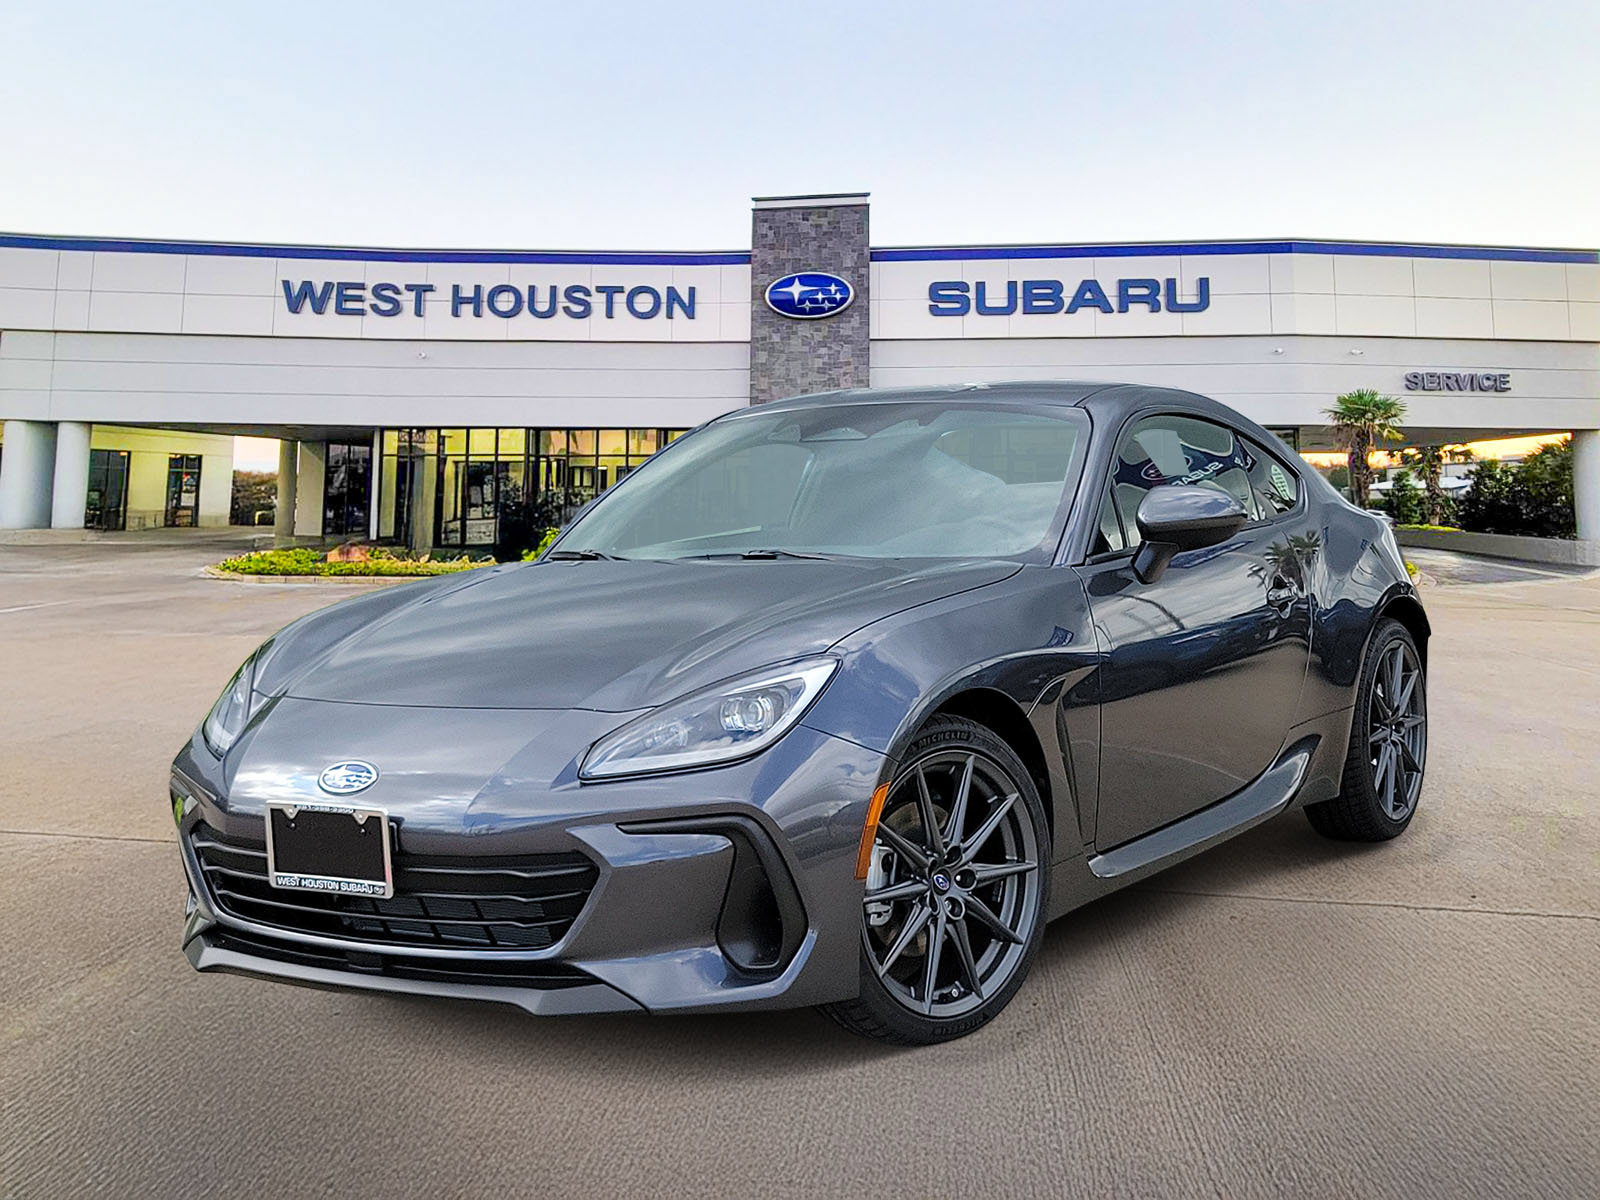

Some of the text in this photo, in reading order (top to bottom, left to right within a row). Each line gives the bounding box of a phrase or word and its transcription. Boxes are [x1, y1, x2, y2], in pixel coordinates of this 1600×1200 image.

[282, 279, 696, 320] WEST HOUSTON
[929, 277, 1210, 317] SUBARU
[1405, 372, 1512, 393] SERVICE
[277, 876, 373, 894] WEST HOUSTON SUBARU
